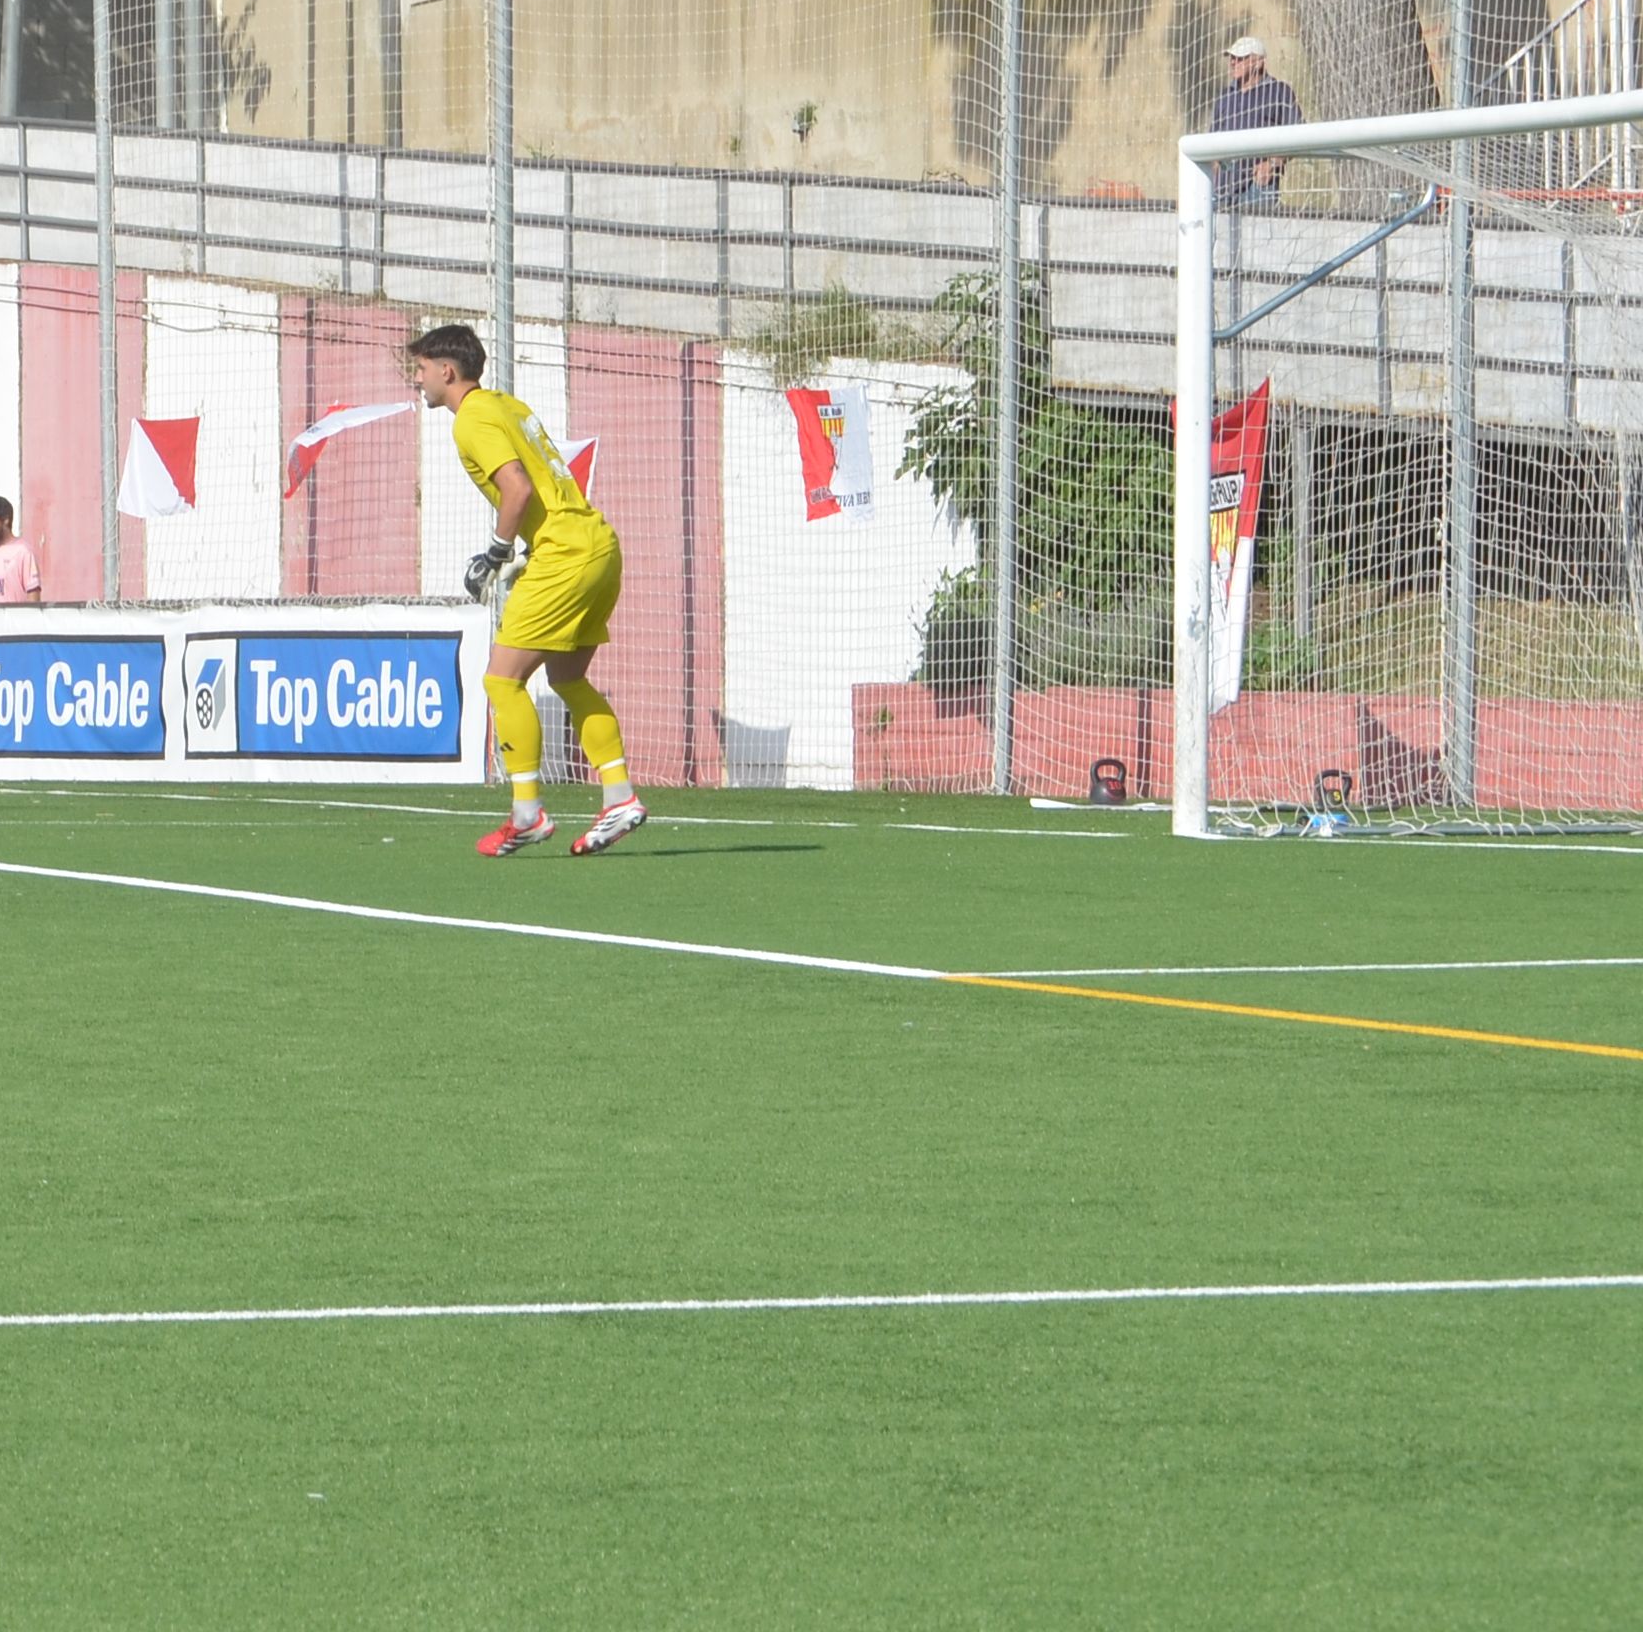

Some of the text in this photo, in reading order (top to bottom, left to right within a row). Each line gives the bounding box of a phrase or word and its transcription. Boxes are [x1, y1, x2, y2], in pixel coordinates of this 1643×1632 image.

[46, 661, 150, 728] Cable
[250, 659, 443, 744] Top Cable
